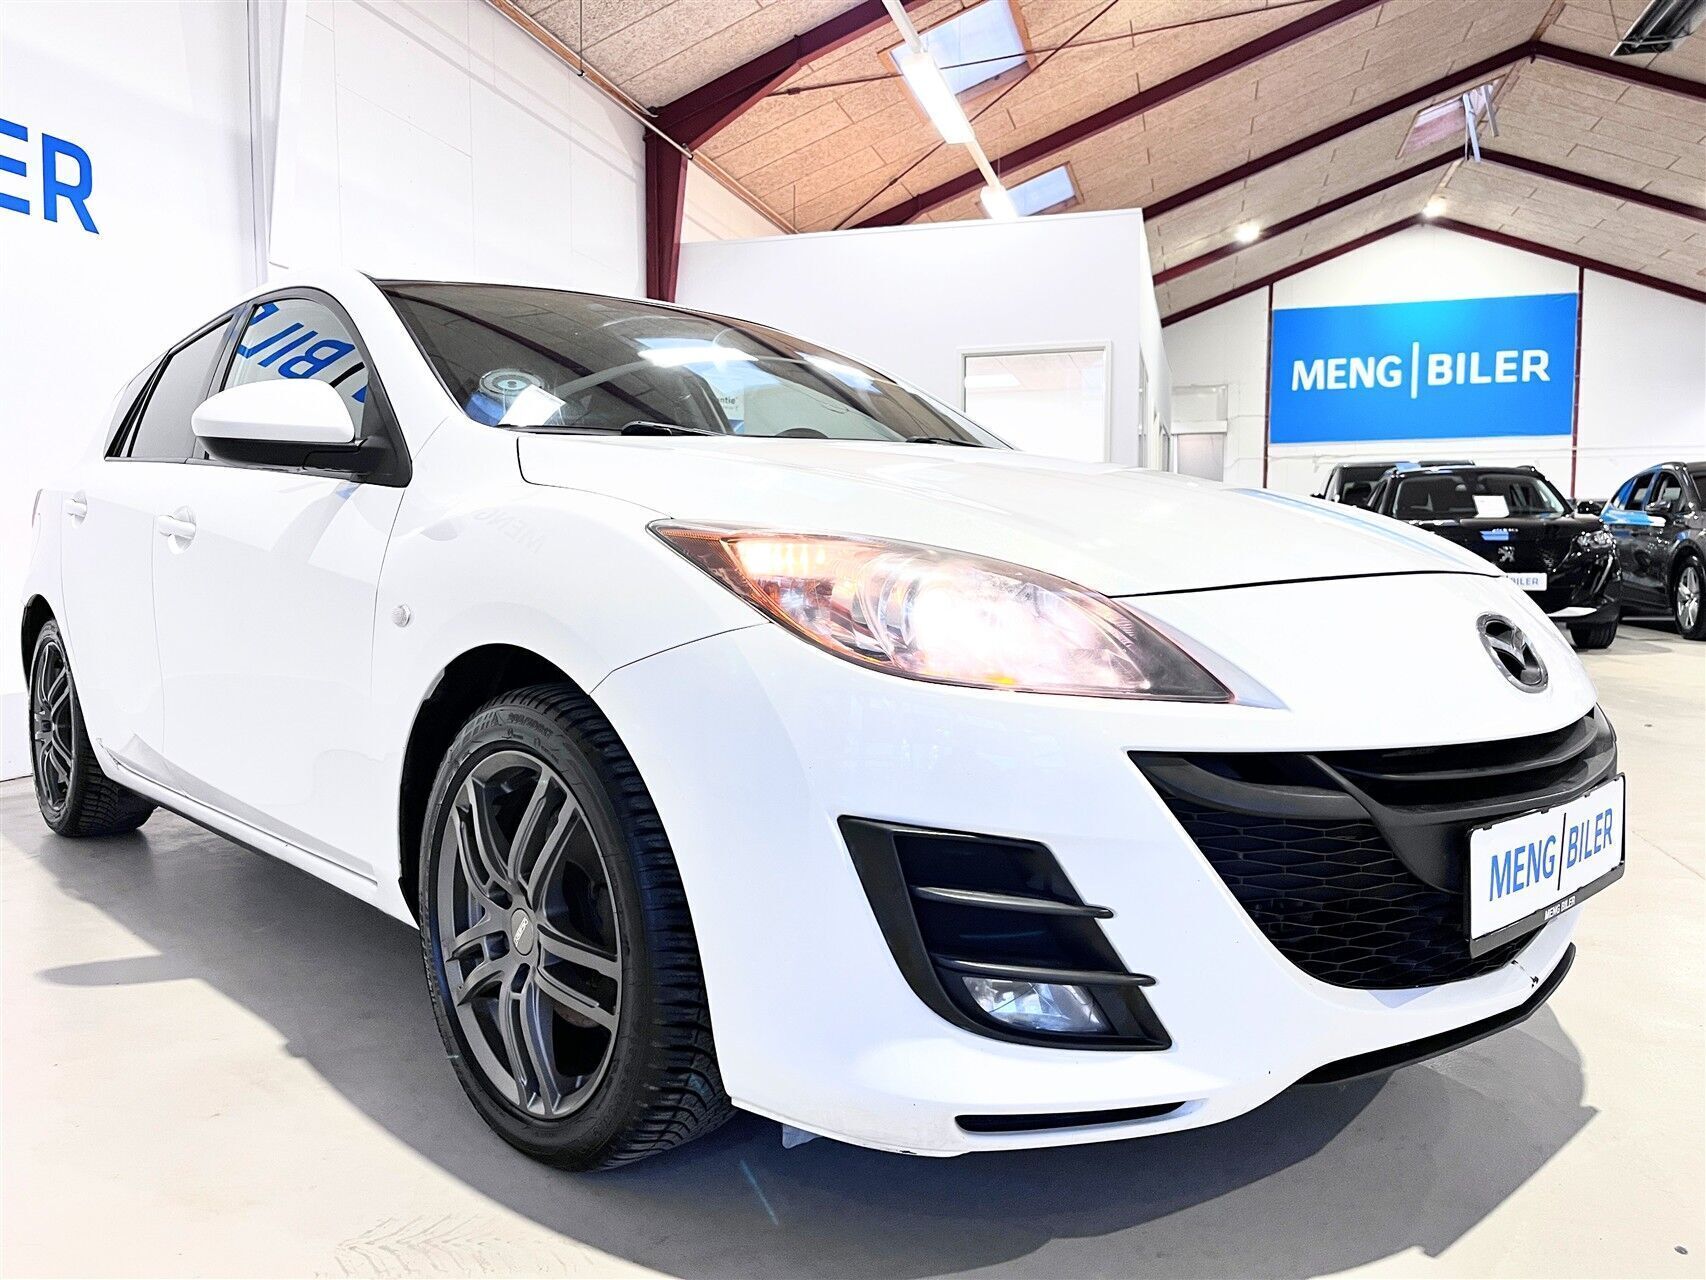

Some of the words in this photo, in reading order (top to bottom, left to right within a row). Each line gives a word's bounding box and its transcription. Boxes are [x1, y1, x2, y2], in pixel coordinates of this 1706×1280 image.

[1291, 355, 1401, 391] MENG
[1427, 349, 1550, 386] BILER
[1489, 835, 1556, 902] MENG
[1567, 808, 1613, 869] BILER
[1544, 903, 1560, 920] MENG
[1561, 895, 1576, 912] BILER
